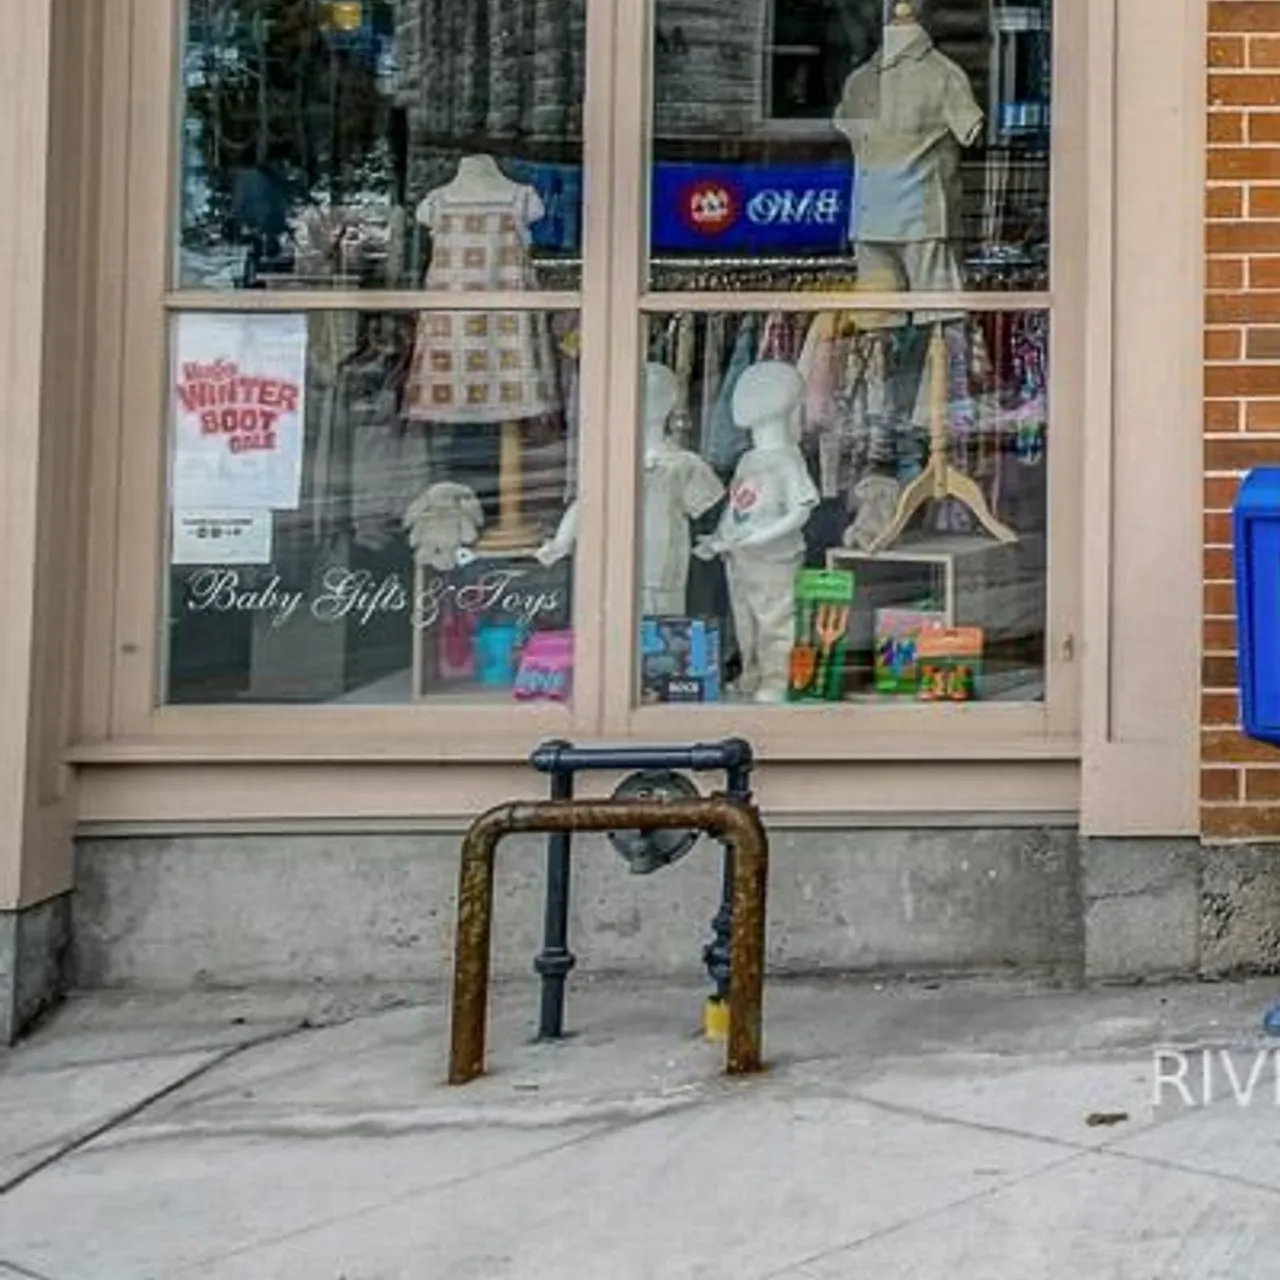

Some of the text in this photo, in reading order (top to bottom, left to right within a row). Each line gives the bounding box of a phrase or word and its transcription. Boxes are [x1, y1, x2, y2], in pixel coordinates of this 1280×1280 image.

[177, 376, 300, 412] WINTER
[202, 410, 278, 434] BOOT
[187, 569, 302, 628] Baby
[311, 568, 407, 625] Gifts
[456, 570, 560, 634] Toys
